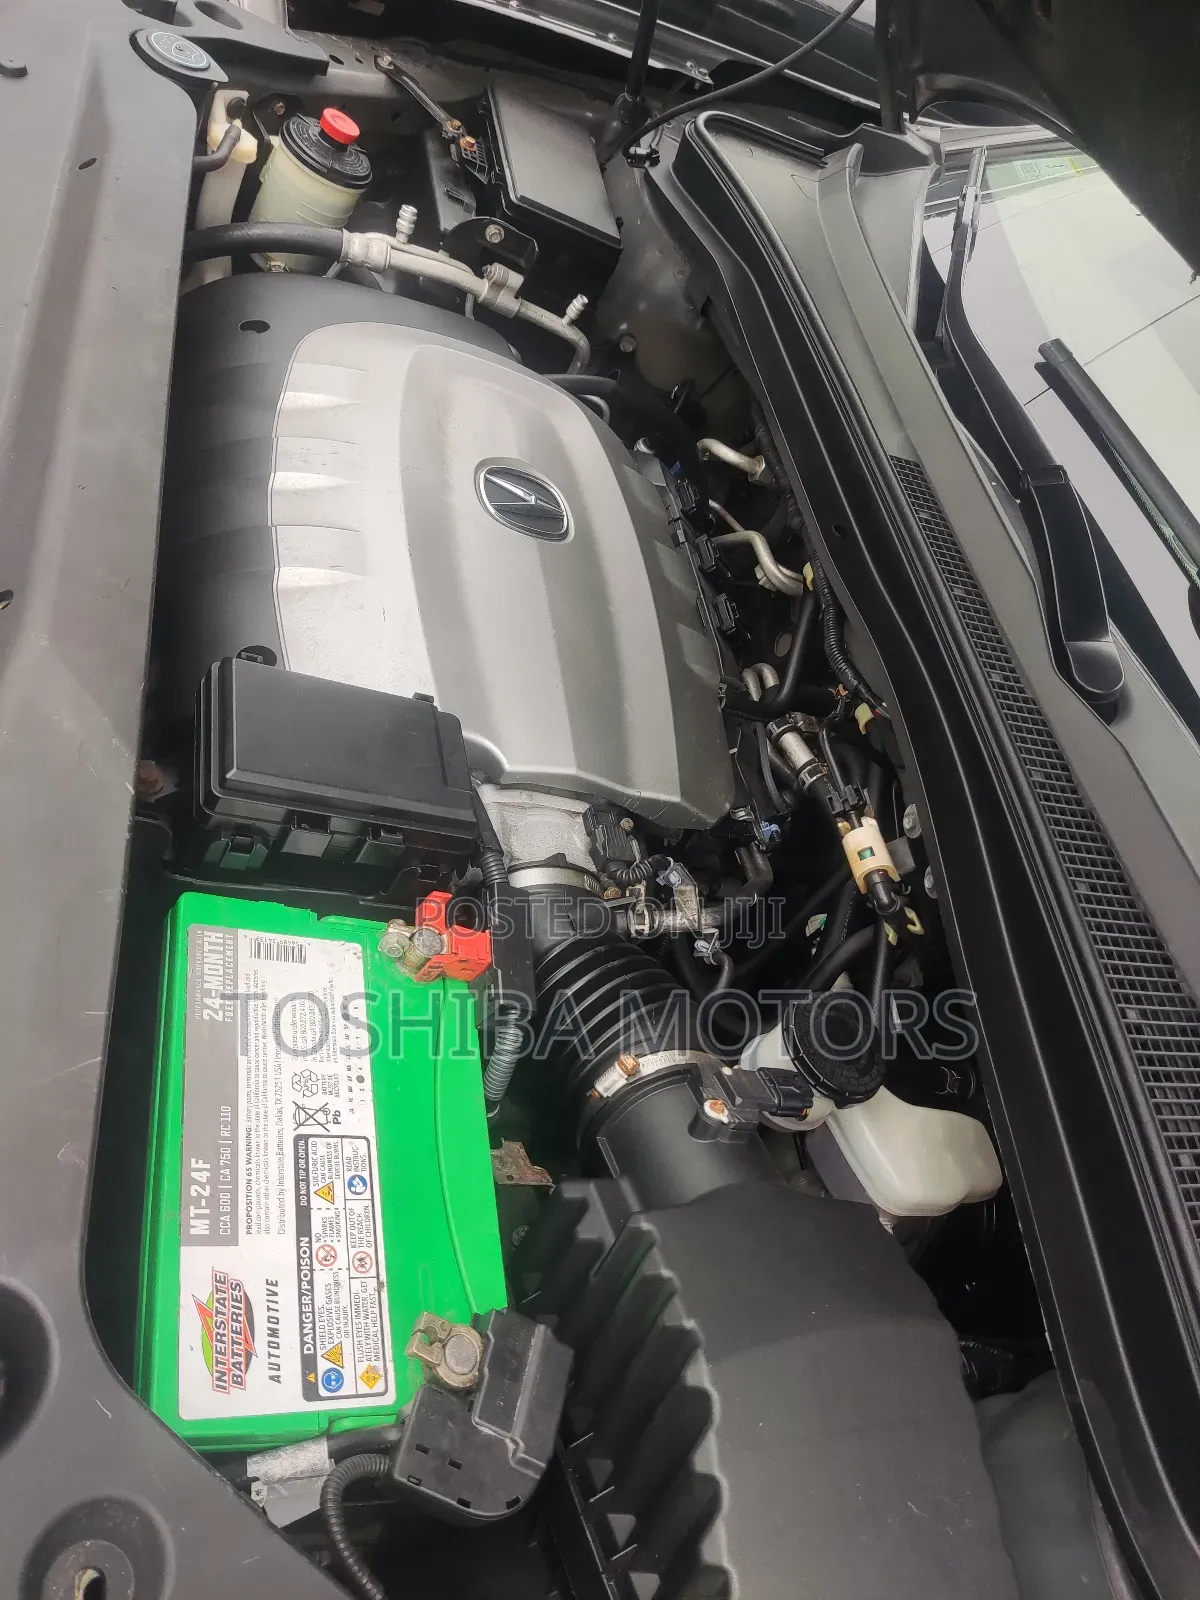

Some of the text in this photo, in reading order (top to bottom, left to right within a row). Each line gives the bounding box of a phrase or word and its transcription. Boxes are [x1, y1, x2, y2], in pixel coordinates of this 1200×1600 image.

[203, 931, 223, 1021] 24-MONTH
[225, 934, 234, 1022] FREE REPLACEMENT
[274, 1063, 282, 1075] USA
[274, 1077, 282, 1096] 75251
[275, 1097, 282, 1105] TX
[221, 1106, 231, 1122] 110
[275, 1106, 284, 1126] Dallas,
[332, 1110, 342, 1125] Pb
[221, 1124, 230, 1136] RC
[276, 1128, 284, 1156] Batteries,
[298, 1138, 306, 1158] OPEN.
[326, 1142, 332, 1150] OR
[220, 1147, 231, 1166] 750
[298, 1159, 306, 1168] OR
[310, 1141, 319, 1186] SULFURIC ACID
[220, 1168, 230, 1180] CA
[246, 1167, 252, 1177] 65
[276, 1157, 285, 1186] Interstate
[298, 1170, 306, 1179] TIP
[190, 1158, 210, 1234] MT-24F
[220, 1192, 230, 1212] 600
[300, 1196, 307, 1206] DO
[277, 1198, 286, 1234] Distributed
[349, 1207, 355, 1216] OF
[220, 1215, 230, 1234] CCA
[364, 1204, 372, 1248] OF CHILDREN.
[315, 1233, 322, 1243] NO
[300, 1237, 314, 1354] DANGER/POISON
[332, 1271, 340, 1304] BLINDNESS
[214, 1272, 228, 1391] INTERSTATE
[230, 1280, 244, 1386] BATTERIES
[266, 1278, 282, 1384] AUTOMOTIVE
[326, 1306, 335, 1344] EXPLOSIVE
[344, 1330, 349, 1338] OR
